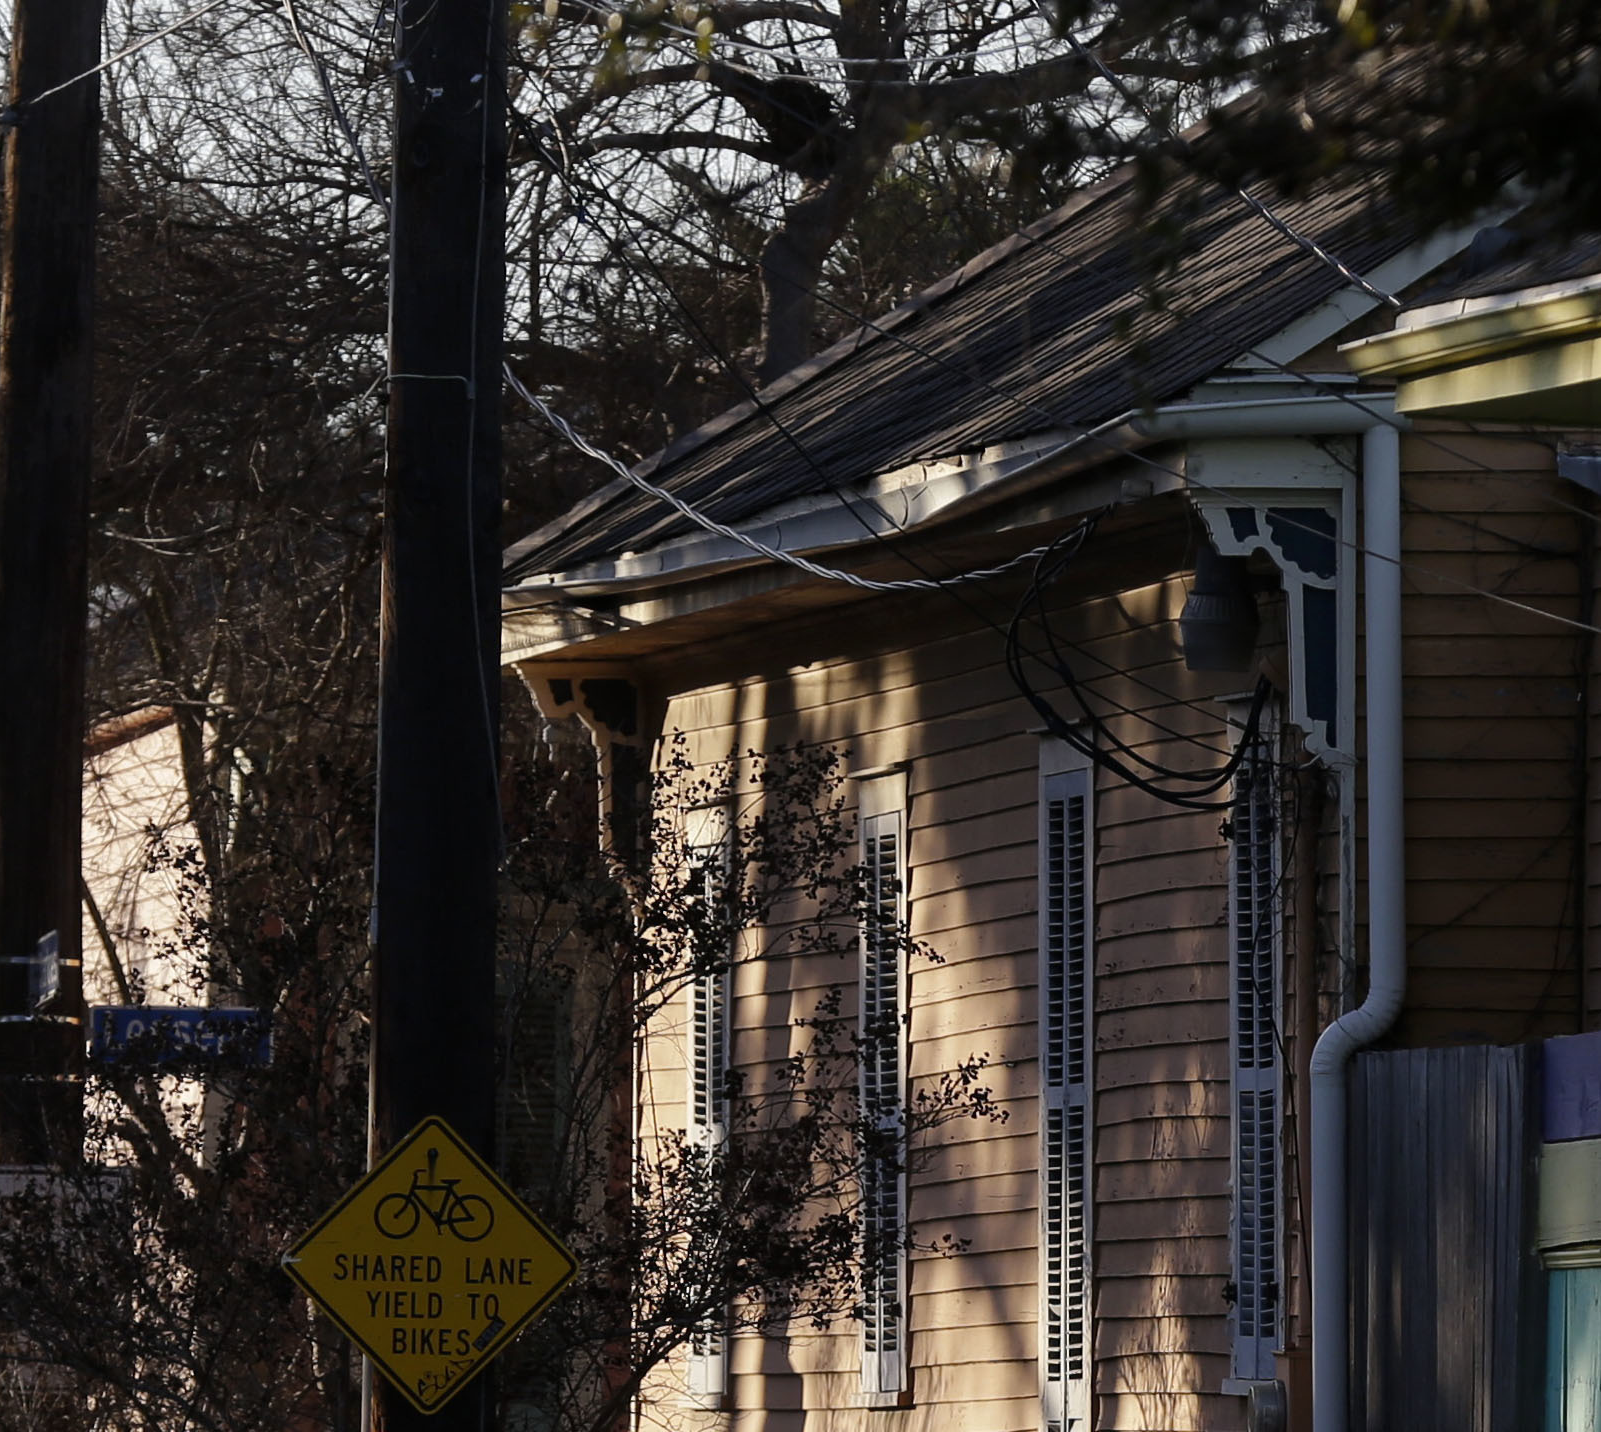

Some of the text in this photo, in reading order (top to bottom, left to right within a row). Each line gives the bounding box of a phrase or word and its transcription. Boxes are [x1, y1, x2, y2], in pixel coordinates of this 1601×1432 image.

[333, 1253, 533, 1286] SHARED LANE
[365, 1290, 500, 1321] YIELD TO
[392, 1327, 471, 1356] BIKES
